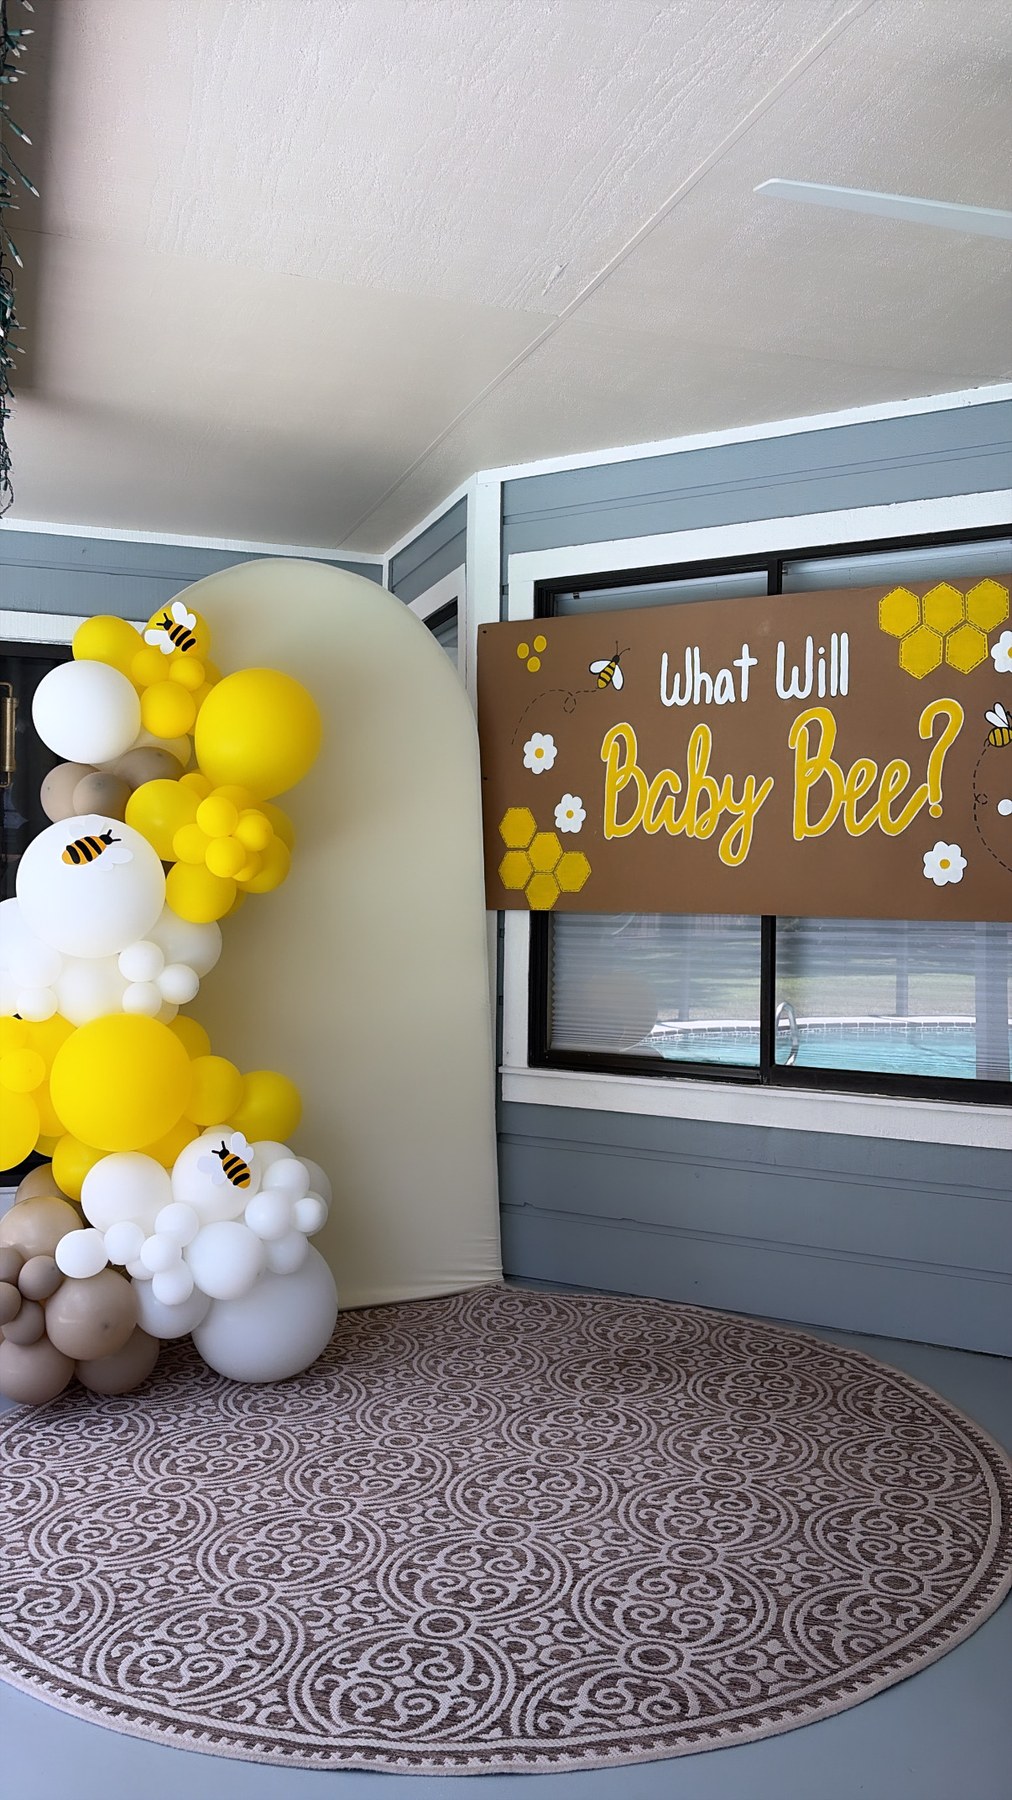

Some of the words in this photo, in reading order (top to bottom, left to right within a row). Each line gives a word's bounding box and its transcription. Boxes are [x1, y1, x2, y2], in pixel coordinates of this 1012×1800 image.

[659, 643, 758, 707] What
[775, 632, 850, 700] Will
[601, 722, 774, 866] Baby
[788, 697, 965, 841] Bee?
